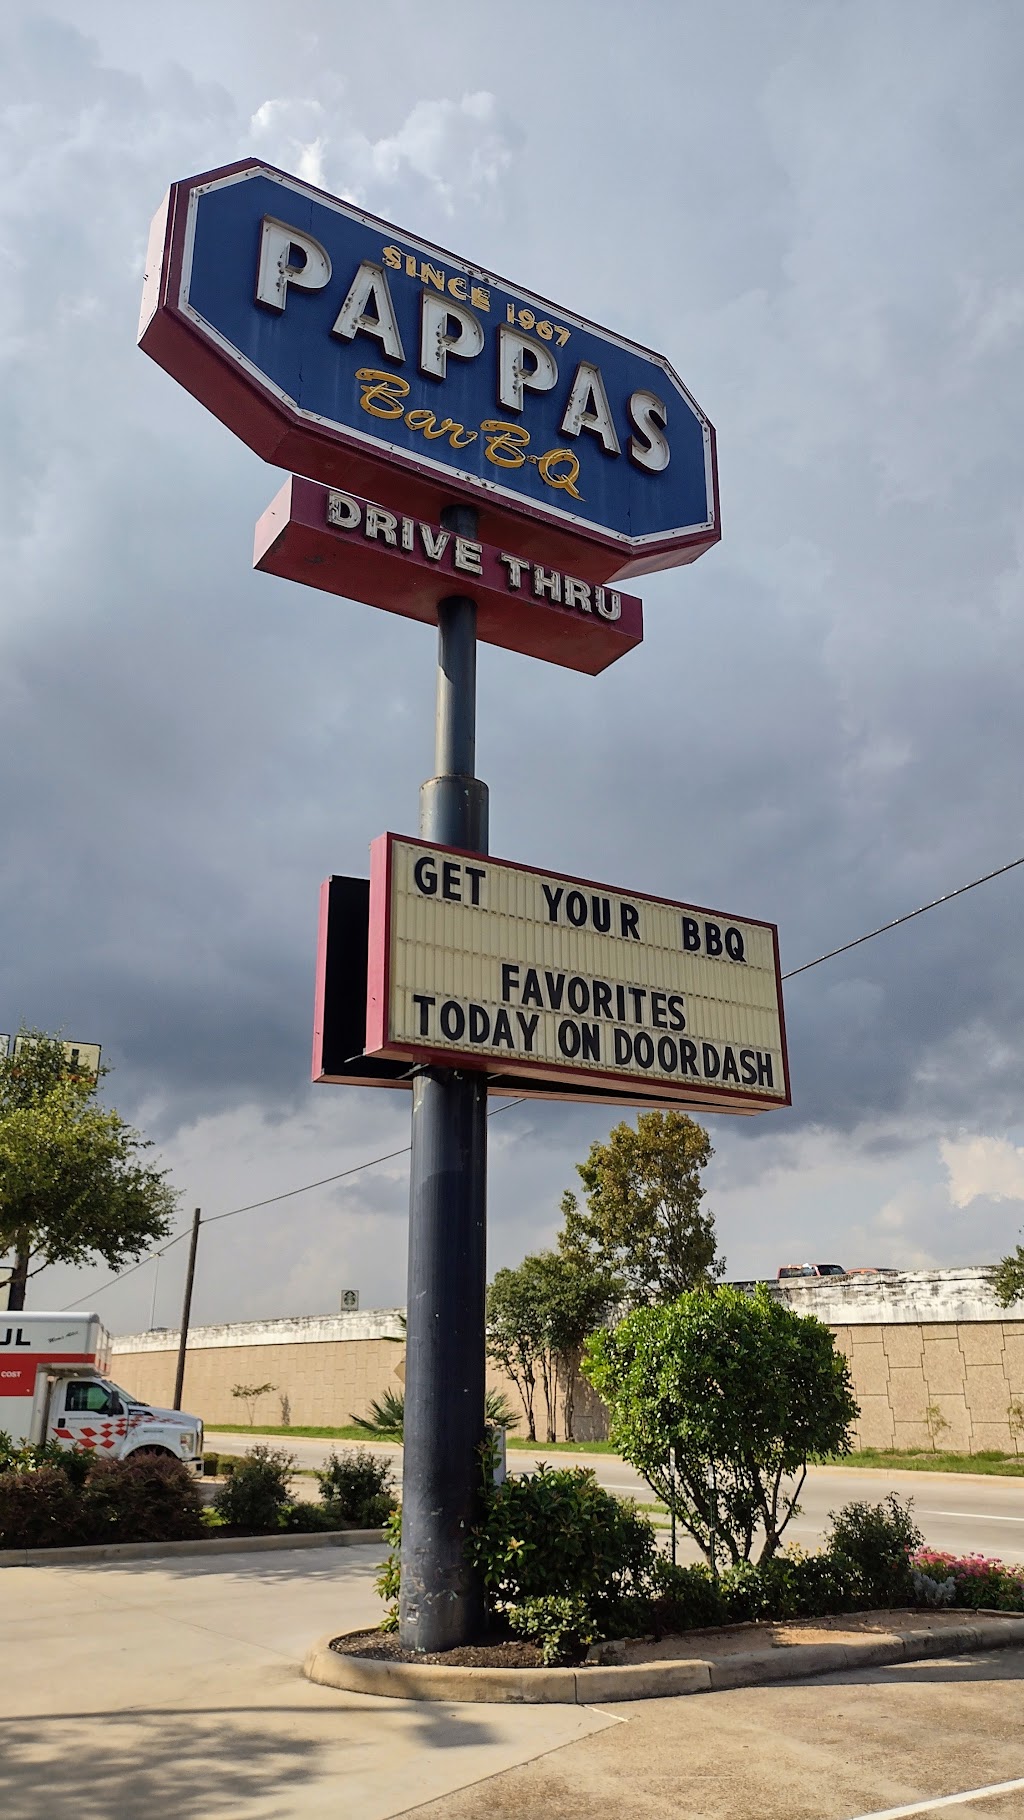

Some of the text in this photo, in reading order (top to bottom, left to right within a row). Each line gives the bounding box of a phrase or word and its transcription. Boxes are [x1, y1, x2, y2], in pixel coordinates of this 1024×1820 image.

[255, 214, 671, 475] PAPPAS
[382, 245, 571, 347] SINCE 1967
[326, 490, 622, 622] DRIVE THRU
[414, 856, 747, 963] GET YOUR BBQ
[413, 994, 775, 1089] TODAY ON DOORDASH
[501, 963, 687, 1032] FAVORITES
[0, 1370, 22, 1378] COST
